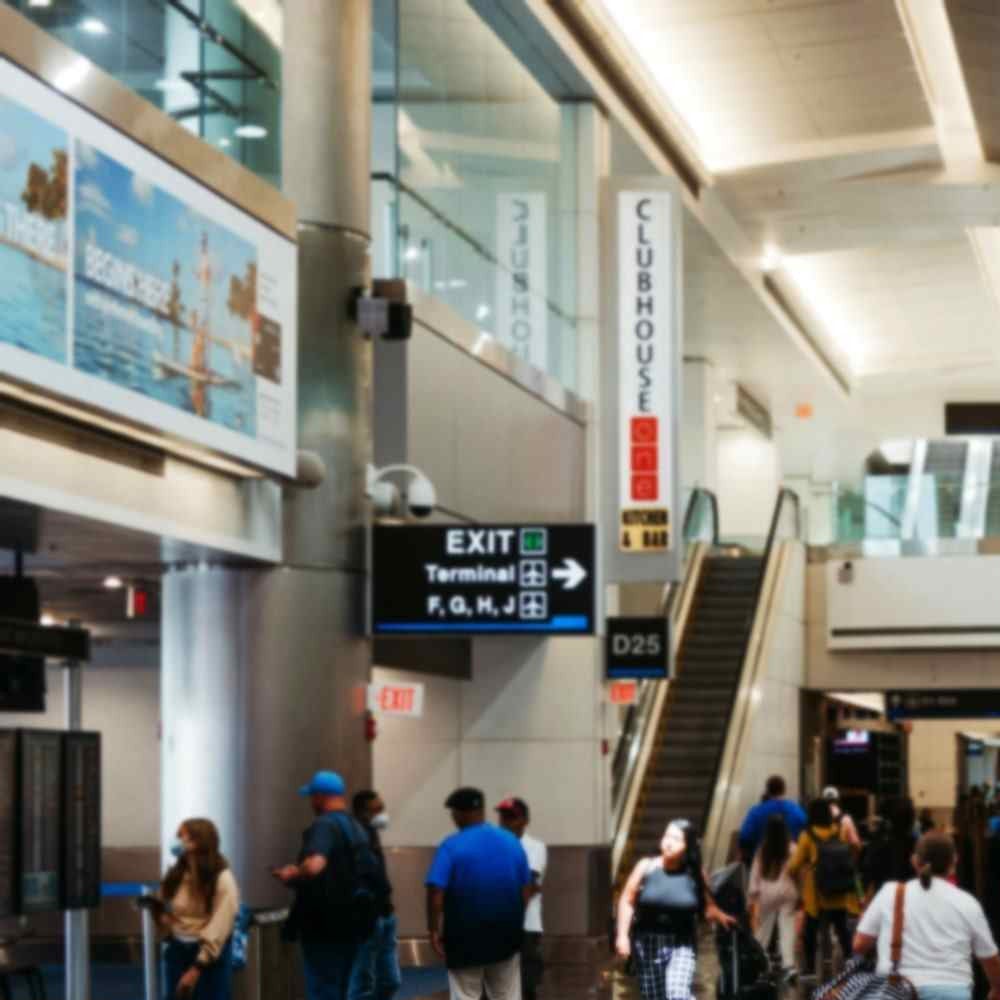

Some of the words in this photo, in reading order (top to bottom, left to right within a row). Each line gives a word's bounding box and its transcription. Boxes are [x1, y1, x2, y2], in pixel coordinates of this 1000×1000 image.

[635, 198, 654, 412] CLUBHOUSE
[446, 529, 515, 555] EXIT
[424, 563, 516, 584] Terminal
[502, 596, 516, 614] J
[612, 634, 661, 655] D25
[378, 686, 415, 711] EXIT
